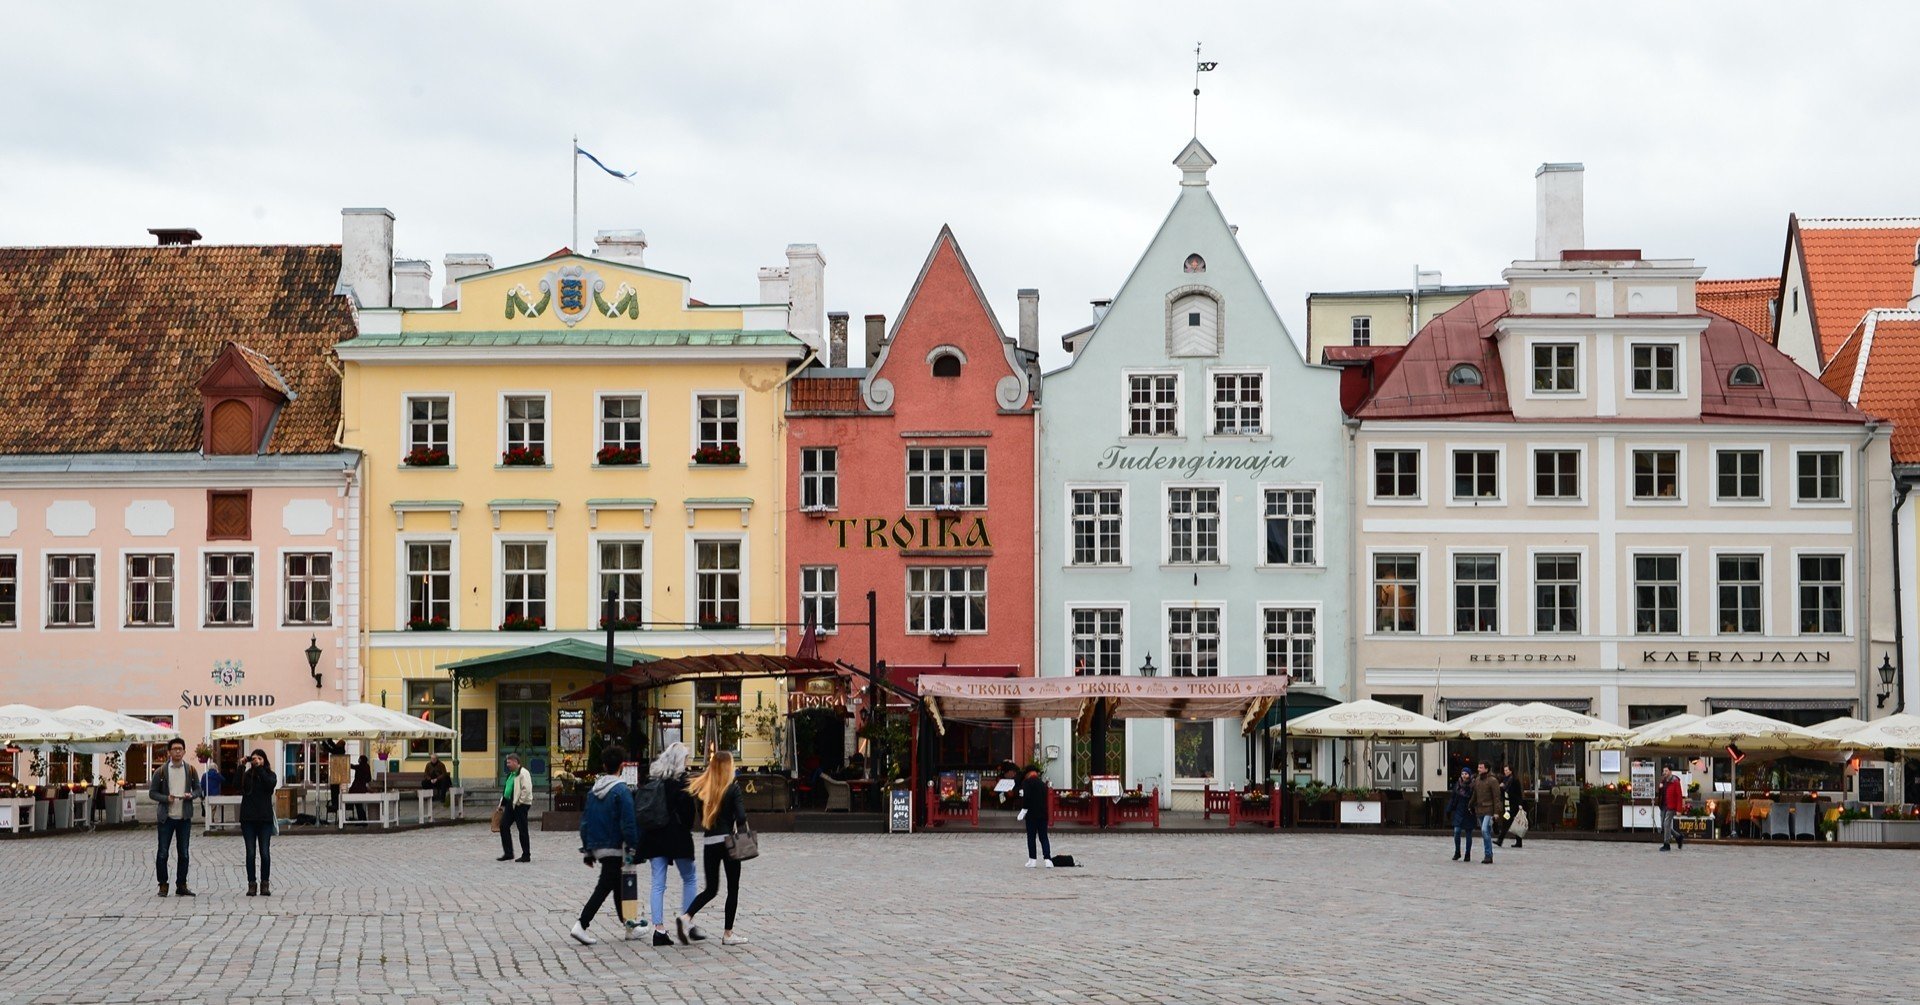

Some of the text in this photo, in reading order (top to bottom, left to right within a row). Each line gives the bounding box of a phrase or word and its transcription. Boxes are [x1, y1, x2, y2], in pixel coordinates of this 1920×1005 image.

[1097, 445, 1295, 480] Tudengimaja
[828, 514, 993, 551] TROIKA
[1470, 653, 1576, 662] RESTORAN
[1643, 650, 1831, 663] KAERAJAAN
[967, 683, 1021, 696] TROIKA
[1077, 682, 1131, 695] TROIKA
[1187, 682, 1241, 696] TROIKA
[347, 729, 365, 737] saku
[1305, 727, 1322, 735] saku
[1346, 728, 1363, 736] saku
[1428, 729, 1446, 737] saku
[1525, 731, 1543, 739] saku
